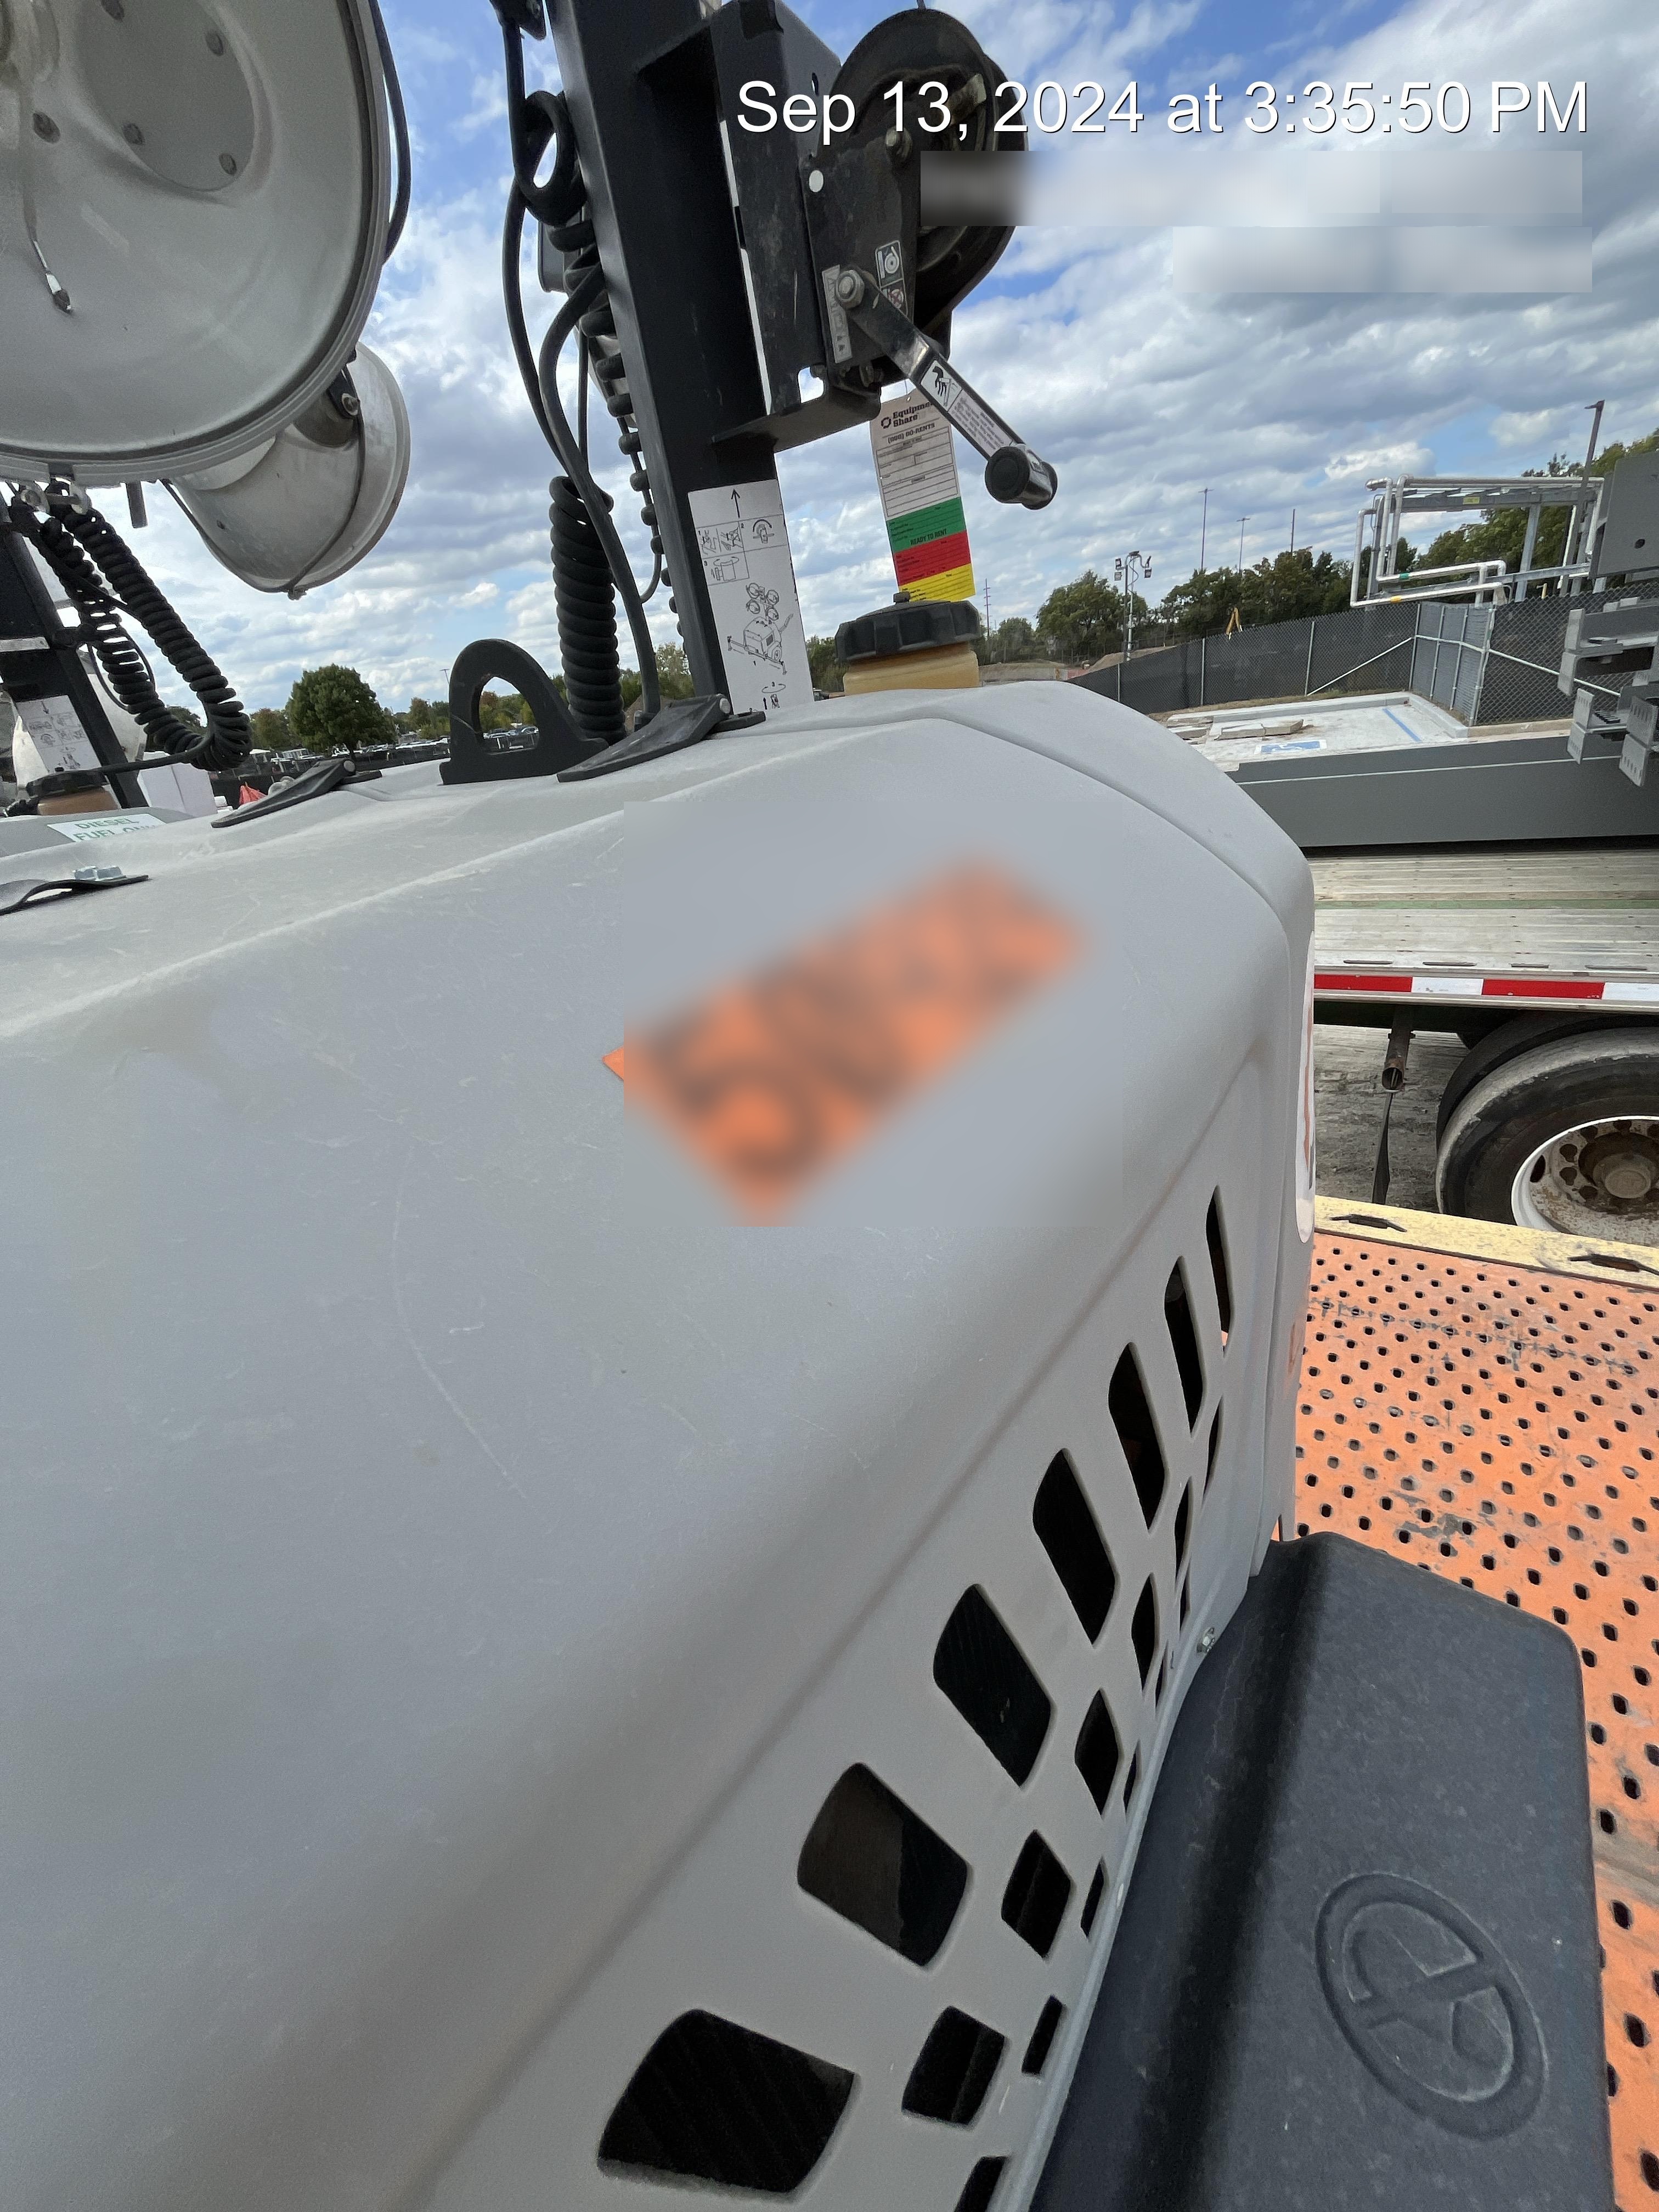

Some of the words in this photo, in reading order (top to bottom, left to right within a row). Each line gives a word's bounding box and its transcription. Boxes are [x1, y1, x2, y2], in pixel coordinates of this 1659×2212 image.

[893, 414, 918, 427] Share
[910, 536, 926, 546] READY
[934, 528, 947, 538] RENT
[75, 817, 139, 829] DIESEL
